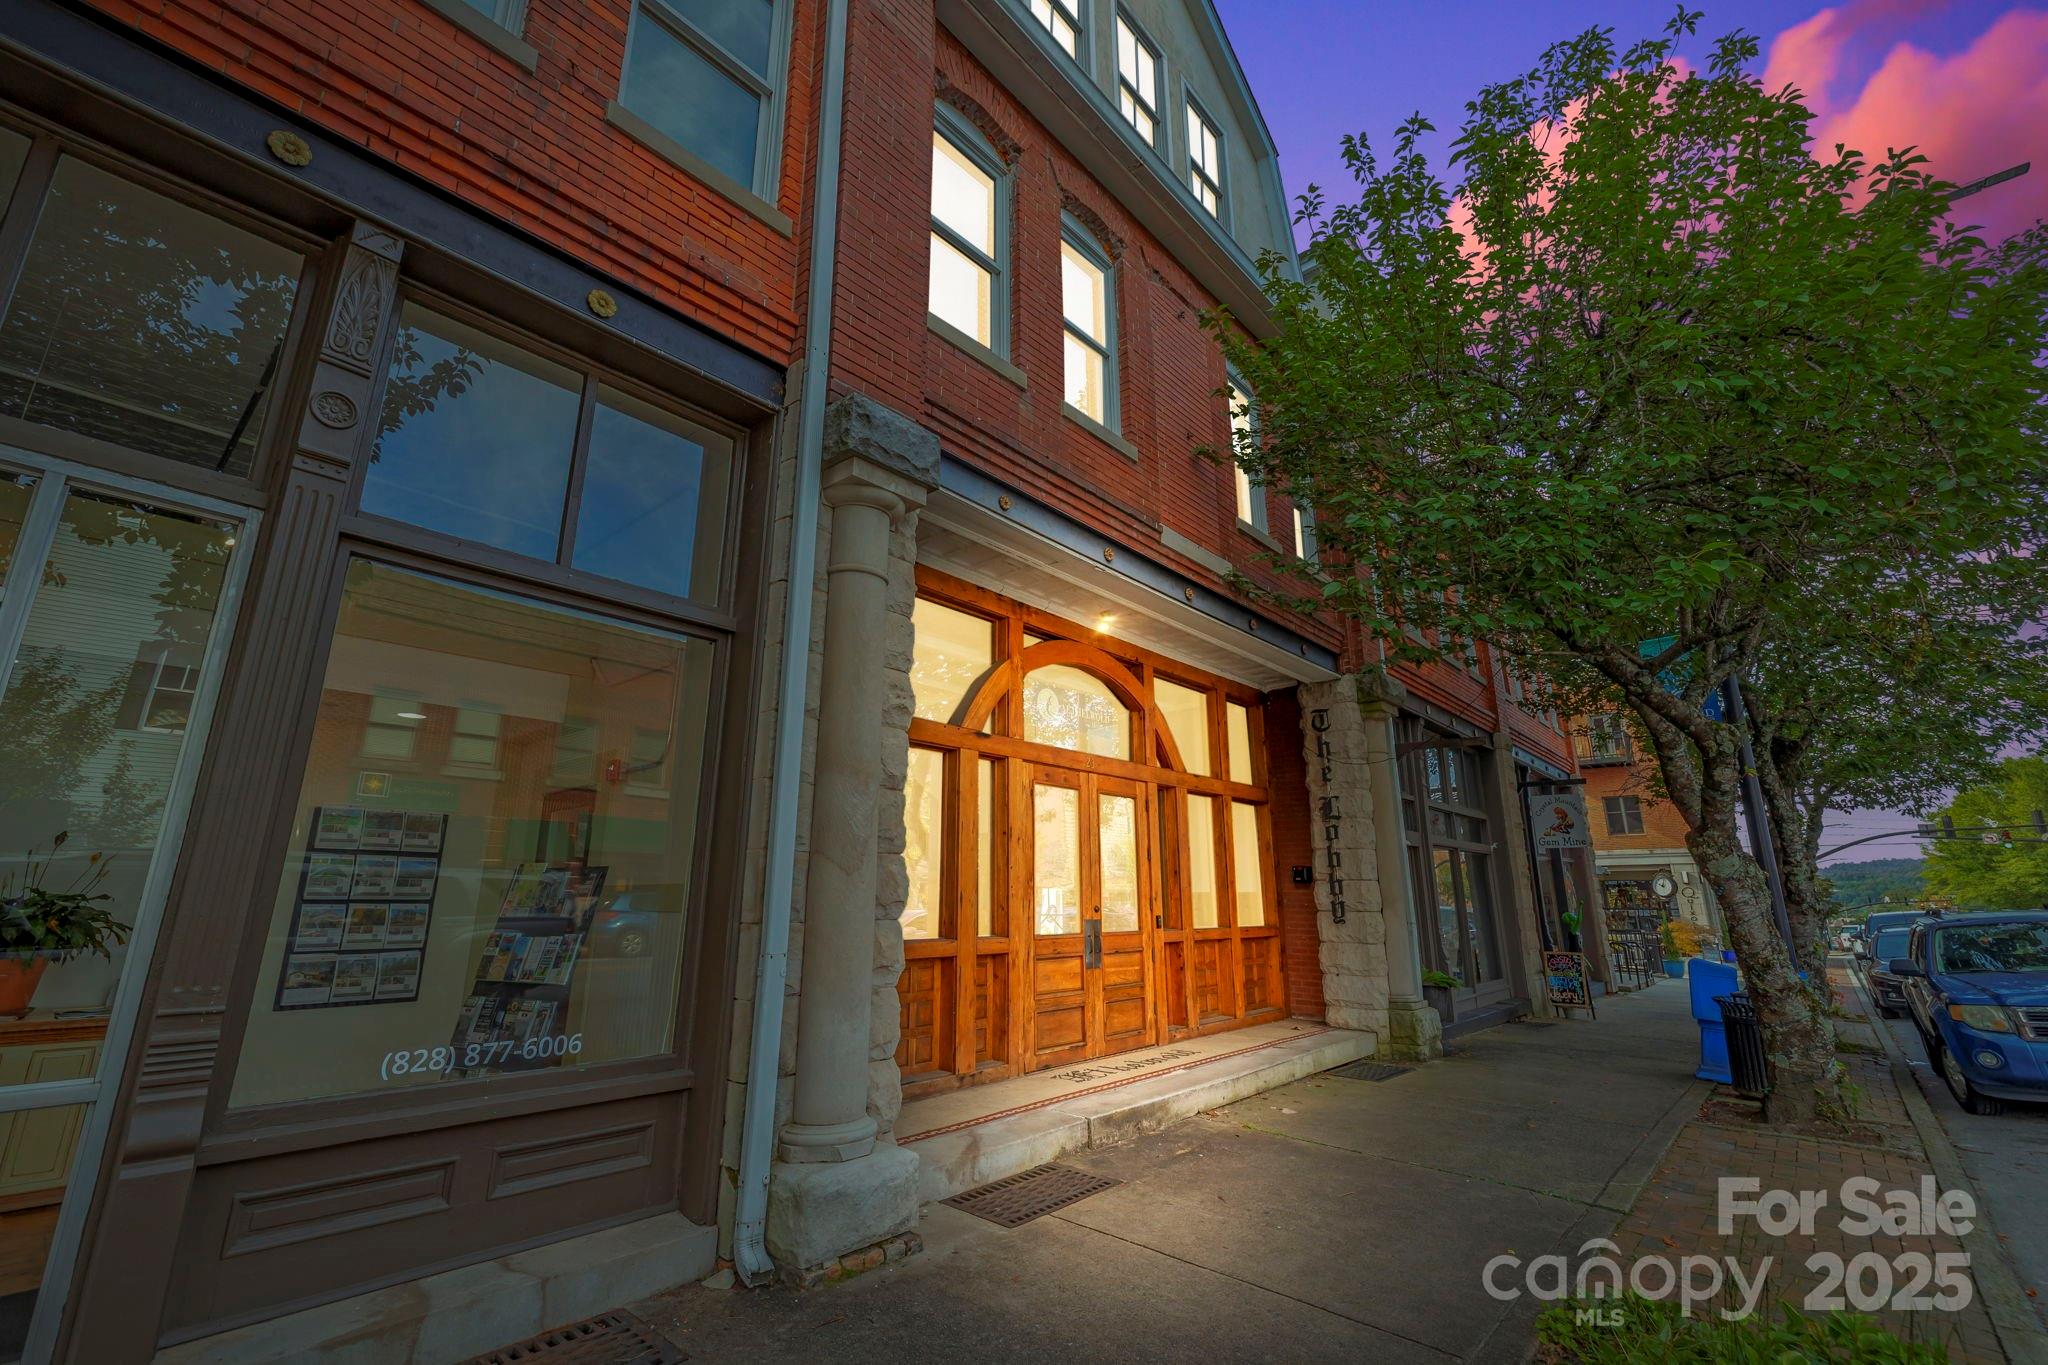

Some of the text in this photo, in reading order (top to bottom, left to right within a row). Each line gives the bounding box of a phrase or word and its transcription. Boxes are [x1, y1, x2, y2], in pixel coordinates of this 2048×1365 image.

[1311, 708, 1346, 925] The Lobby
[1535, 799, 1553, 817] Crystal
[1538, 836, 1587, 847] Gem Mine
[1681, 887, 1699, 923] Quixo
[381, 1033, 584, 1081] (828) 877-6006
